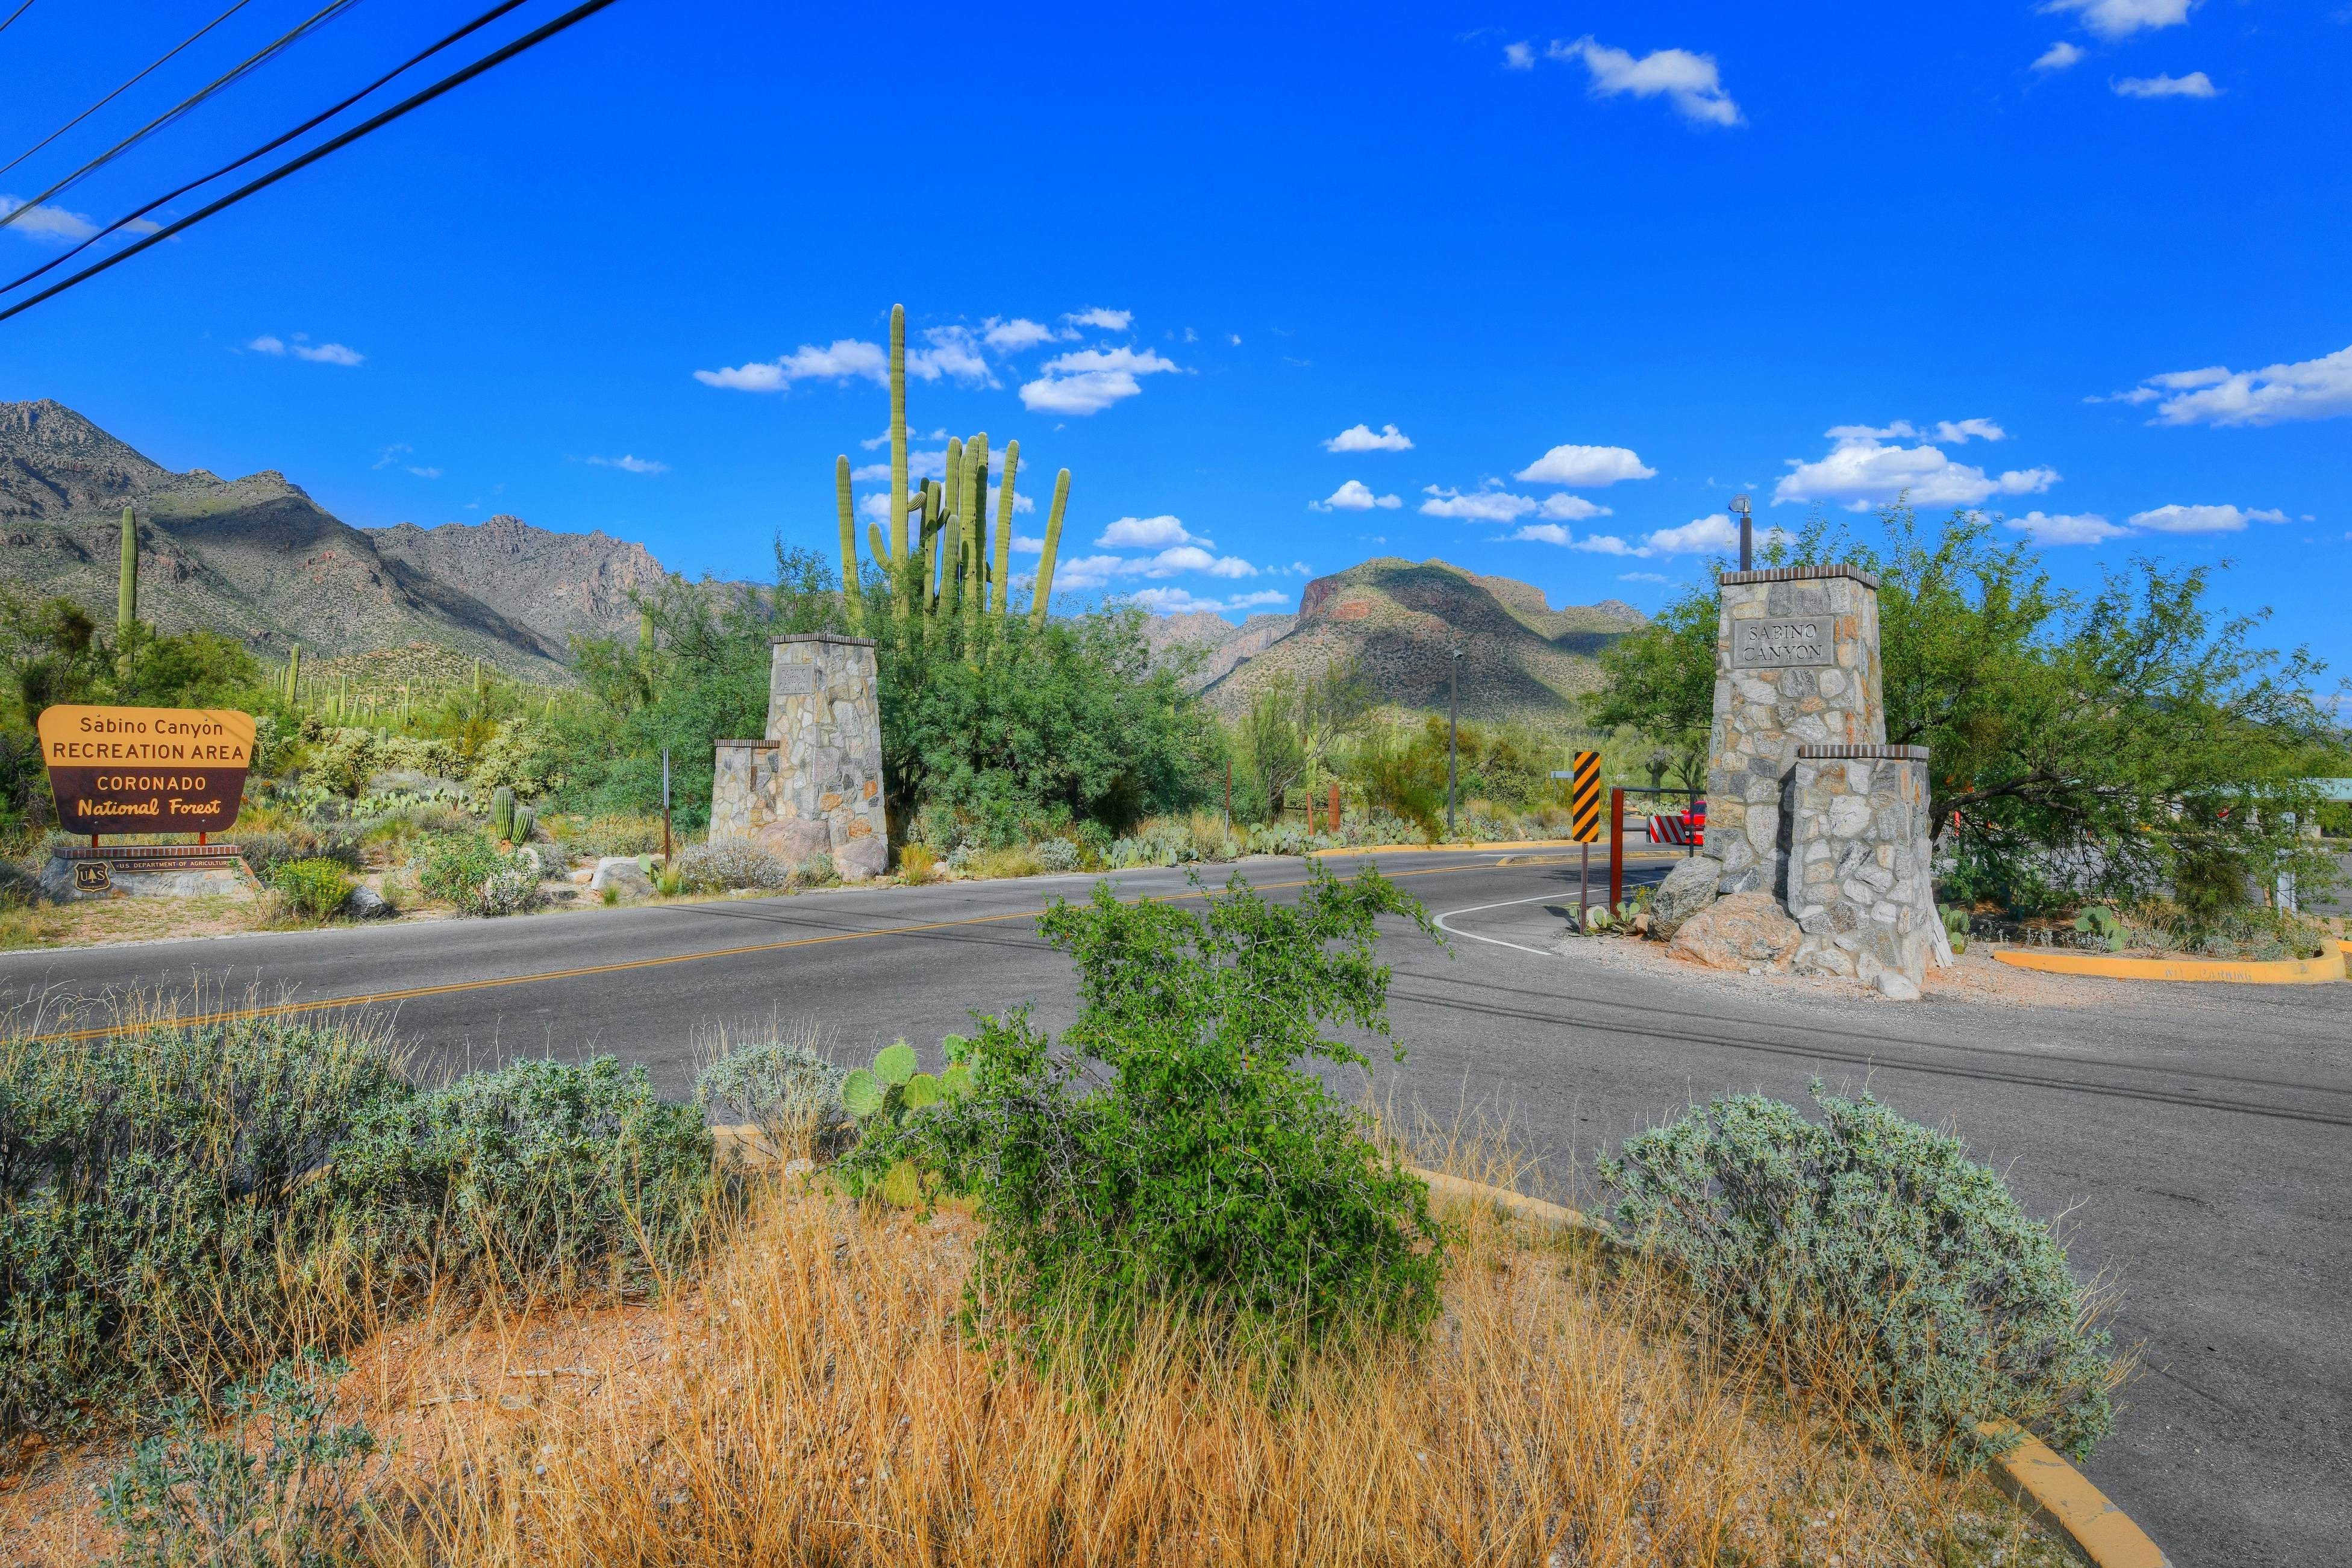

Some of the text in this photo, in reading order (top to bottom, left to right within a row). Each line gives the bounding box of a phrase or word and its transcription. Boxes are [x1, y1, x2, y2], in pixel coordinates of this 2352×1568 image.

[1749, 623, 1817, 640] SABINO
[1743, 645, 1822, 661] CANYON
[781, 669, 806, 678] ABIO
[80, 717, 223, 739] Sabino Canyon
[53, 742, 244, 760] RECREATION AREA
[97, 776, 206, 791] CORONADO
[78, 798, 221, 816] National Forest
